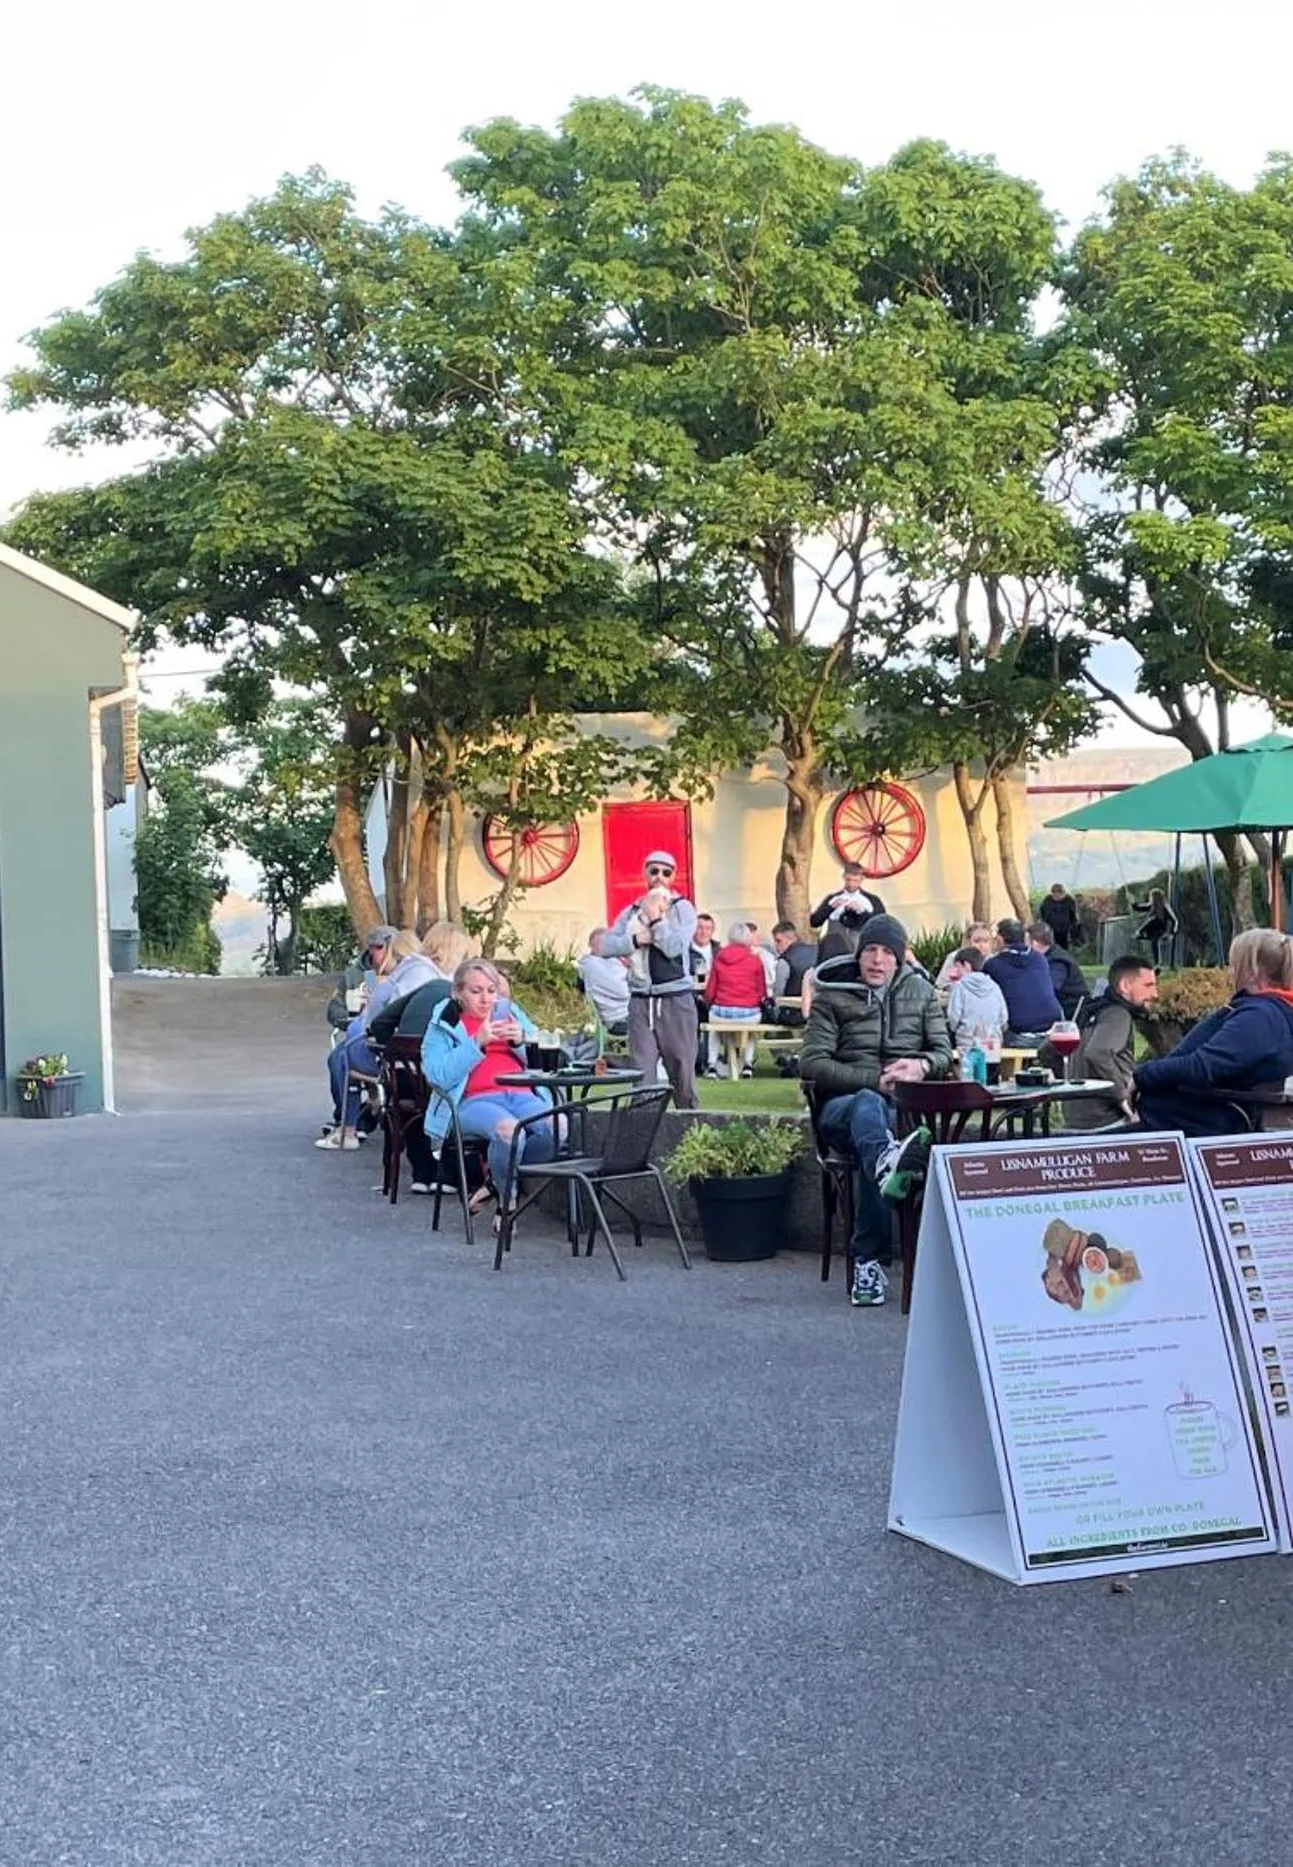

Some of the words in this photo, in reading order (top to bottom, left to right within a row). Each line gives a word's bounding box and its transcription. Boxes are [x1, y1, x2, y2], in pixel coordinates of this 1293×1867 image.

[1001, 1151, 1093, 1172] LISNAMULLIGAN
[1096, 1150, 1131, 1164] FARM
[1250, 1147, 1293, 1161] LISNAM
[1041, 1166, 1097, 1182] PRODUCE
[967, 1207, 992, 1219] THE
[995, 1202, 1060, 1216] DONEGAL
[1063, 1196, 1138, 1213] BREAKFAST
[1142, 1191, 1185, 1205] PLATE
[1076, 1514, 1091, 1525] OR
[1093, 1512, 1117, 1524] FILL
[1117, 1509, 1145, 1521] YOUR
[1147, 1504, 1172, 1518] OWN
[1174, 1500, 1205, 1514] PLATE
[1046, 1535, 1067, 1548] ALL
[1068, 1528, 1139, 1544] INGREDIENTS
[1140, 1525, 1169, 1538] FROM
[1192, 1515, 1242, 1532] DONEGAL
